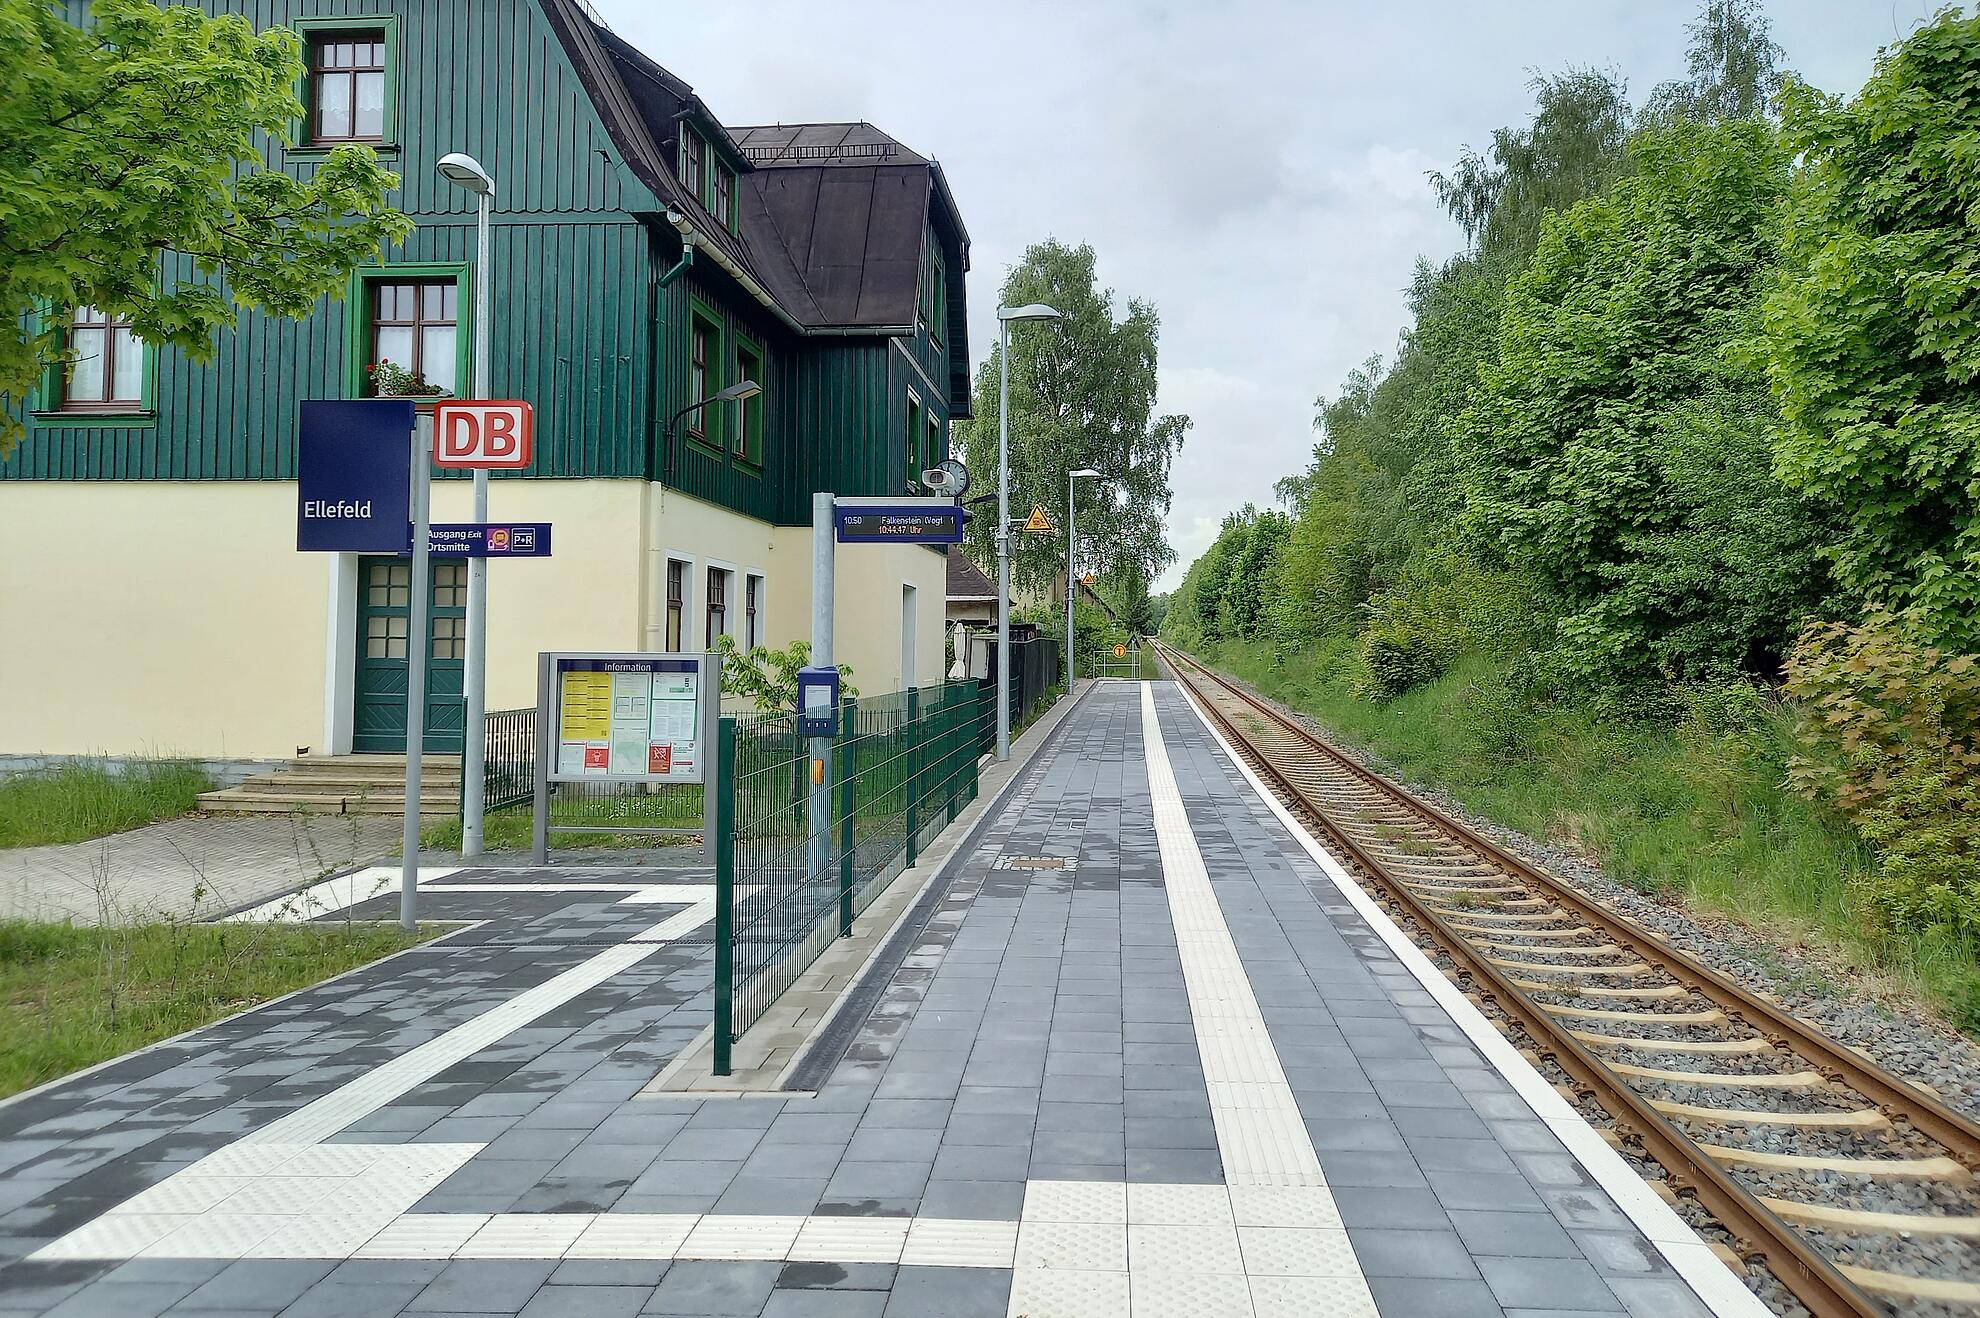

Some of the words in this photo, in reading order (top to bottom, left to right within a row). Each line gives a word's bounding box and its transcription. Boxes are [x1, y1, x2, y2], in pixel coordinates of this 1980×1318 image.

[446, 411, 516, 456] DB
[304, 500, 372, 518] Ellefeld
[881, 516, 922, 525] Falkenstein
[950, 516, 954, 525] 1
[879, 525, 906, 534] 10:44:47
[909, 525, 923, 534] Uhr
[428, 530, 465, 541] Ausgang
[467, 530, 482, 539] Exit
[428, 542, 470, 552] Ortsmitte
[604, 663, 651, 672] Information
